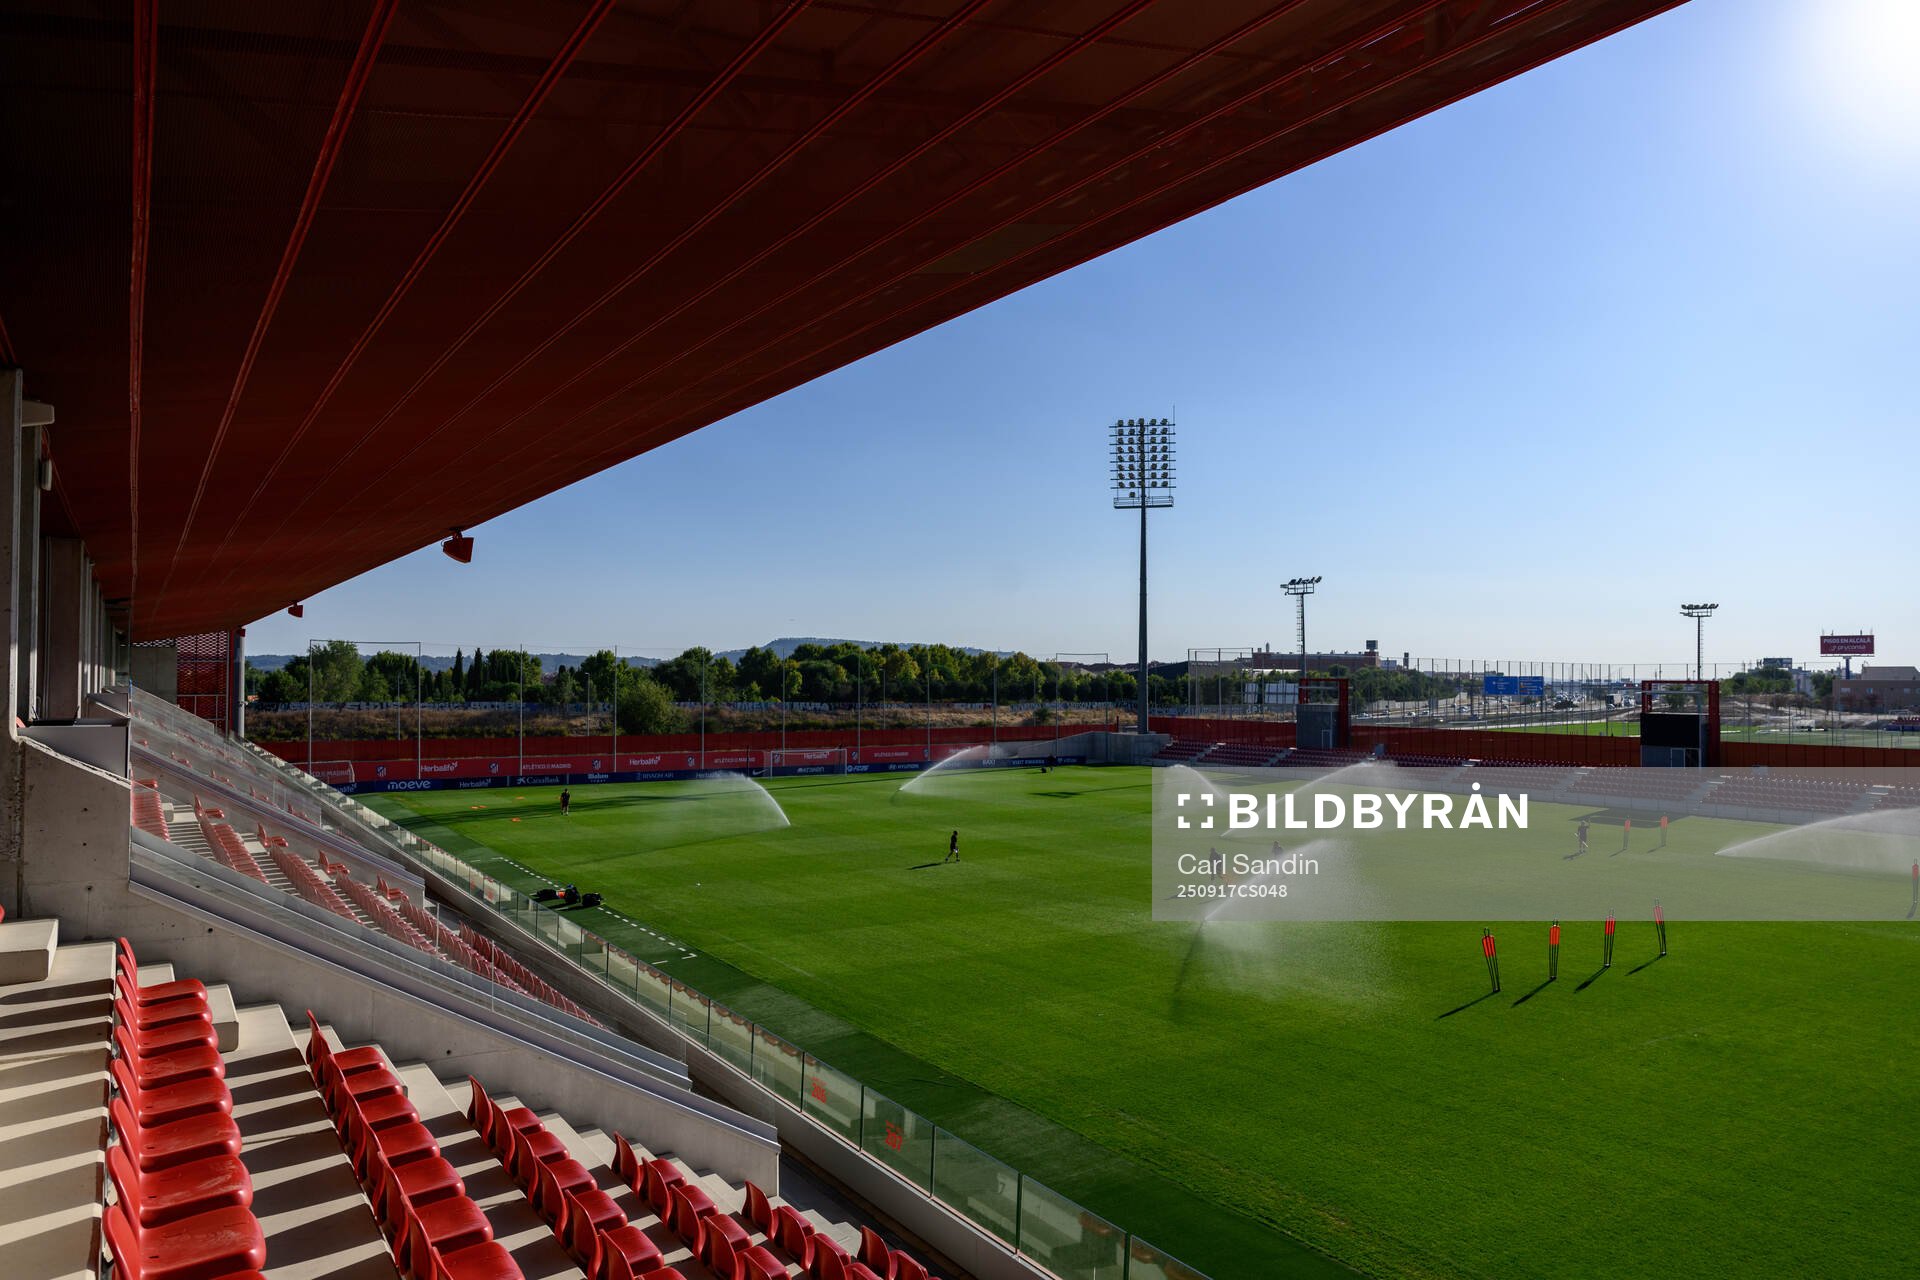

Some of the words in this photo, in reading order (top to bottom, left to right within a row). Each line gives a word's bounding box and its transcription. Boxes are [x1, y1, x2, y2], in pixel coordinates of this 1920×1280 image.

[629, 757, 658, 765] Herbalife
[420, 763, 456, 773] Herbalife
[387, 779, 432, 791] moeve
[459, 779, 488, 789] Herbalife
[526, 776, 560, 785] CaixaBank
